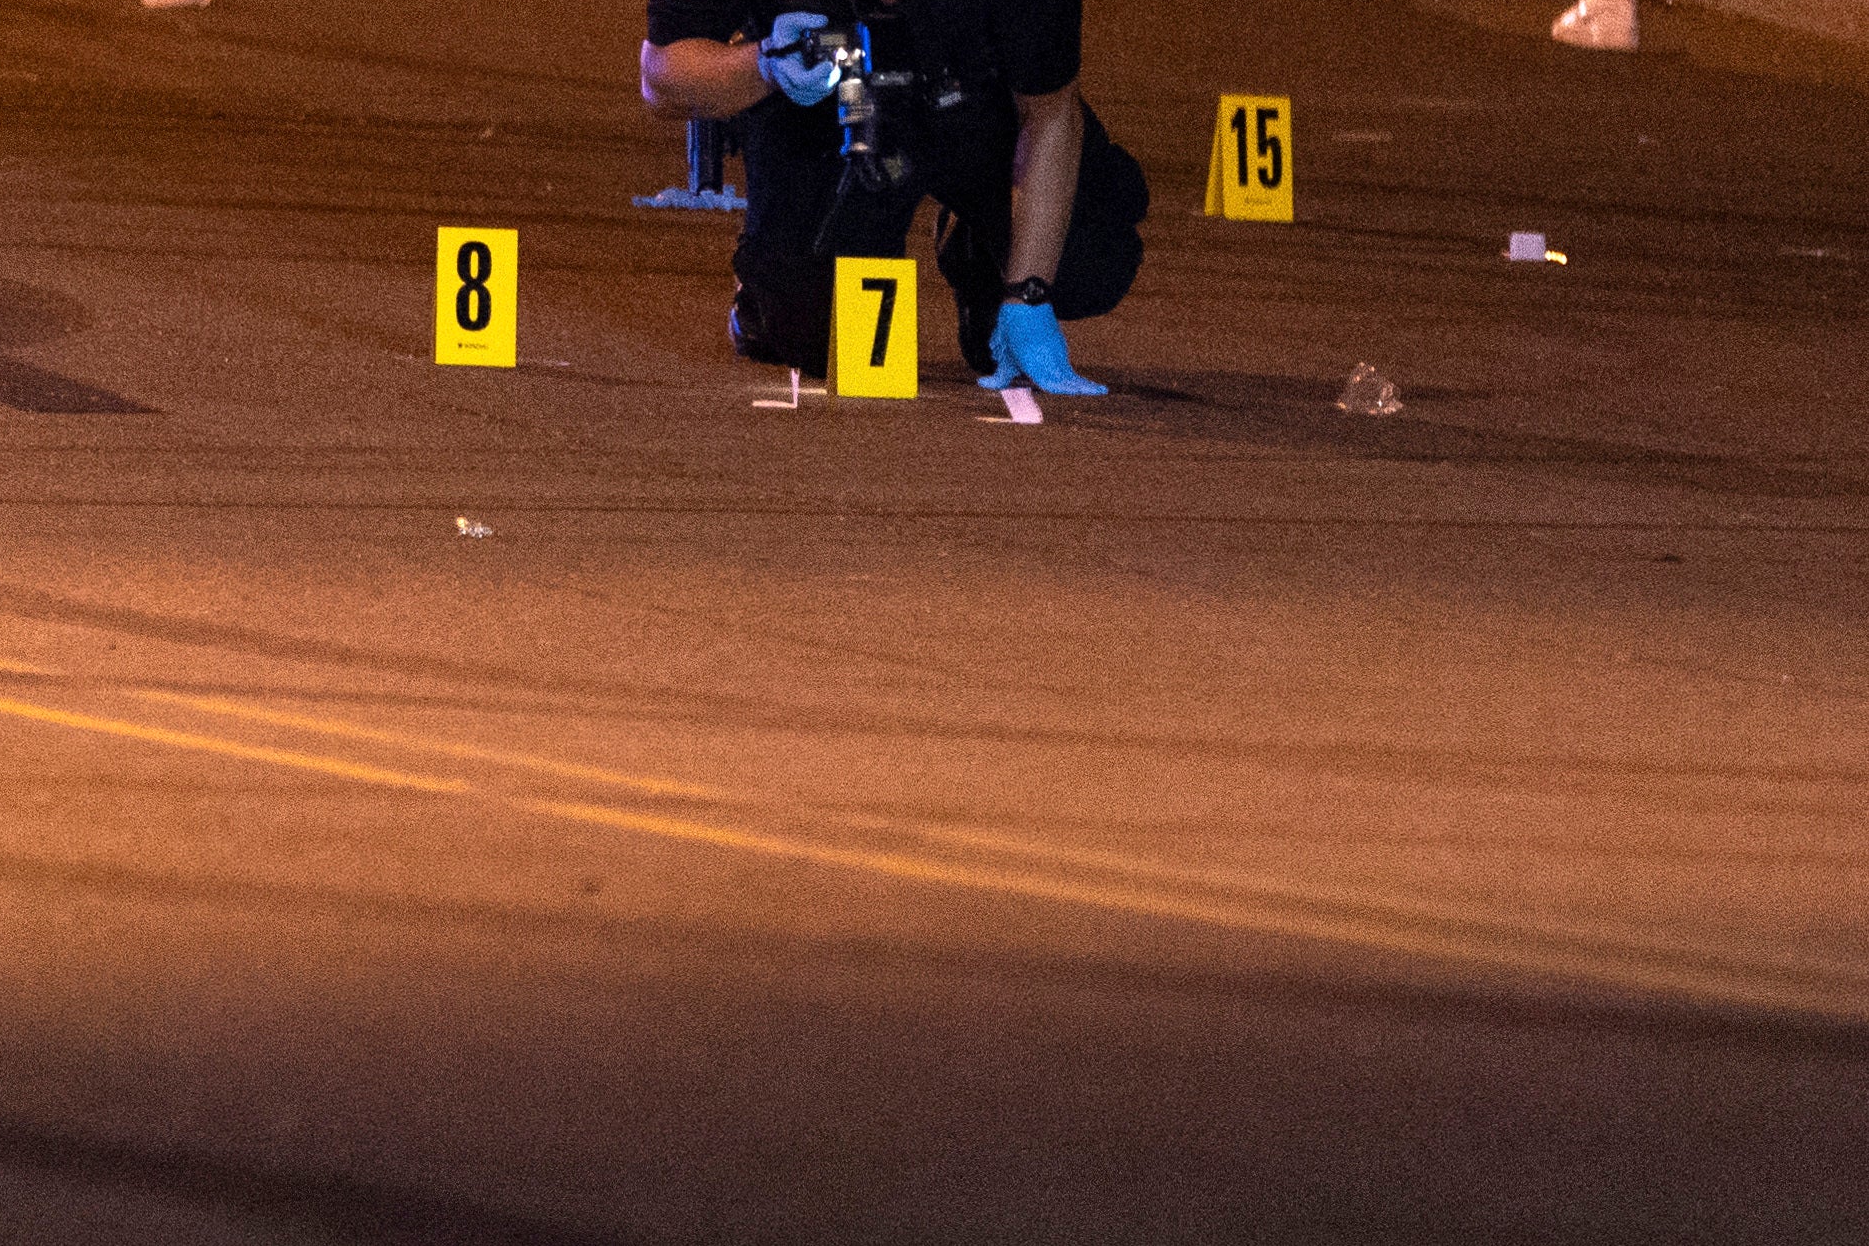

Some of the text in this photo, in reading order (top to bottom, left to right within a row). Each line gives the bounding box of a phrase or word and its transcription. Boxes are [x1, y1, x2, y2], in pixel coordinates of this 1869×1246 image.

[1230, 106, 1283, 191] 15
[455, 240, 492, 332] 8
[861, 277, 899, 369] 7
